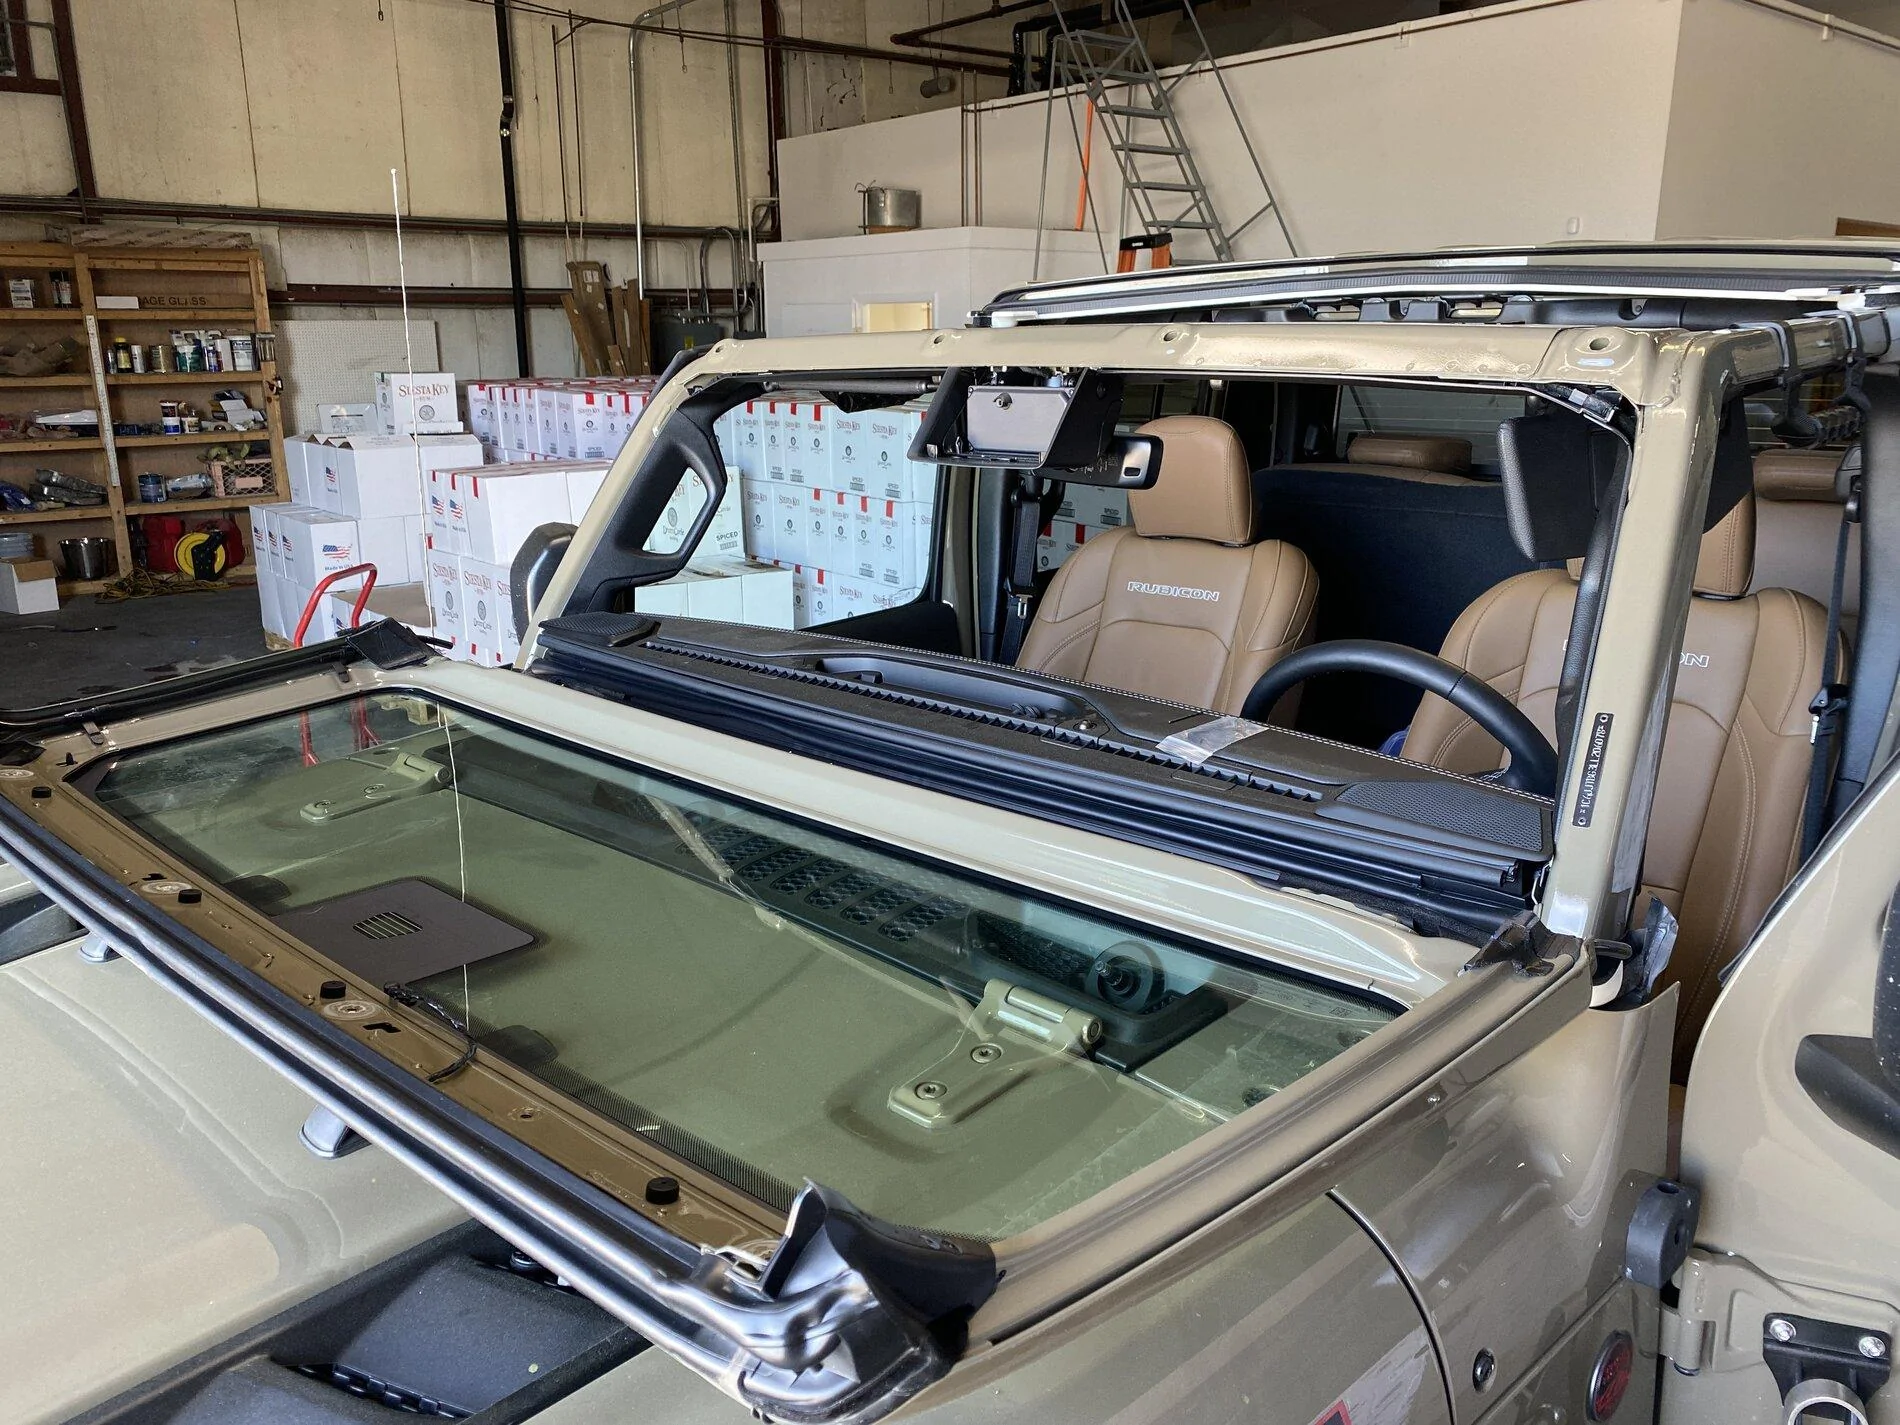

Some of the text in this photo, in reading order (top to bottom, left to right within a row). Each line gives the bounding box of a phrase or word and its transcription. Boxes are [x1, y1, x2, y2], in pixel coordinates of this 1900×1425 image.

[431, 383, 449, 397] KEY
[716, 531, 739, 541] SPICED
[1127, 581, 1220, 602] RUBICON
